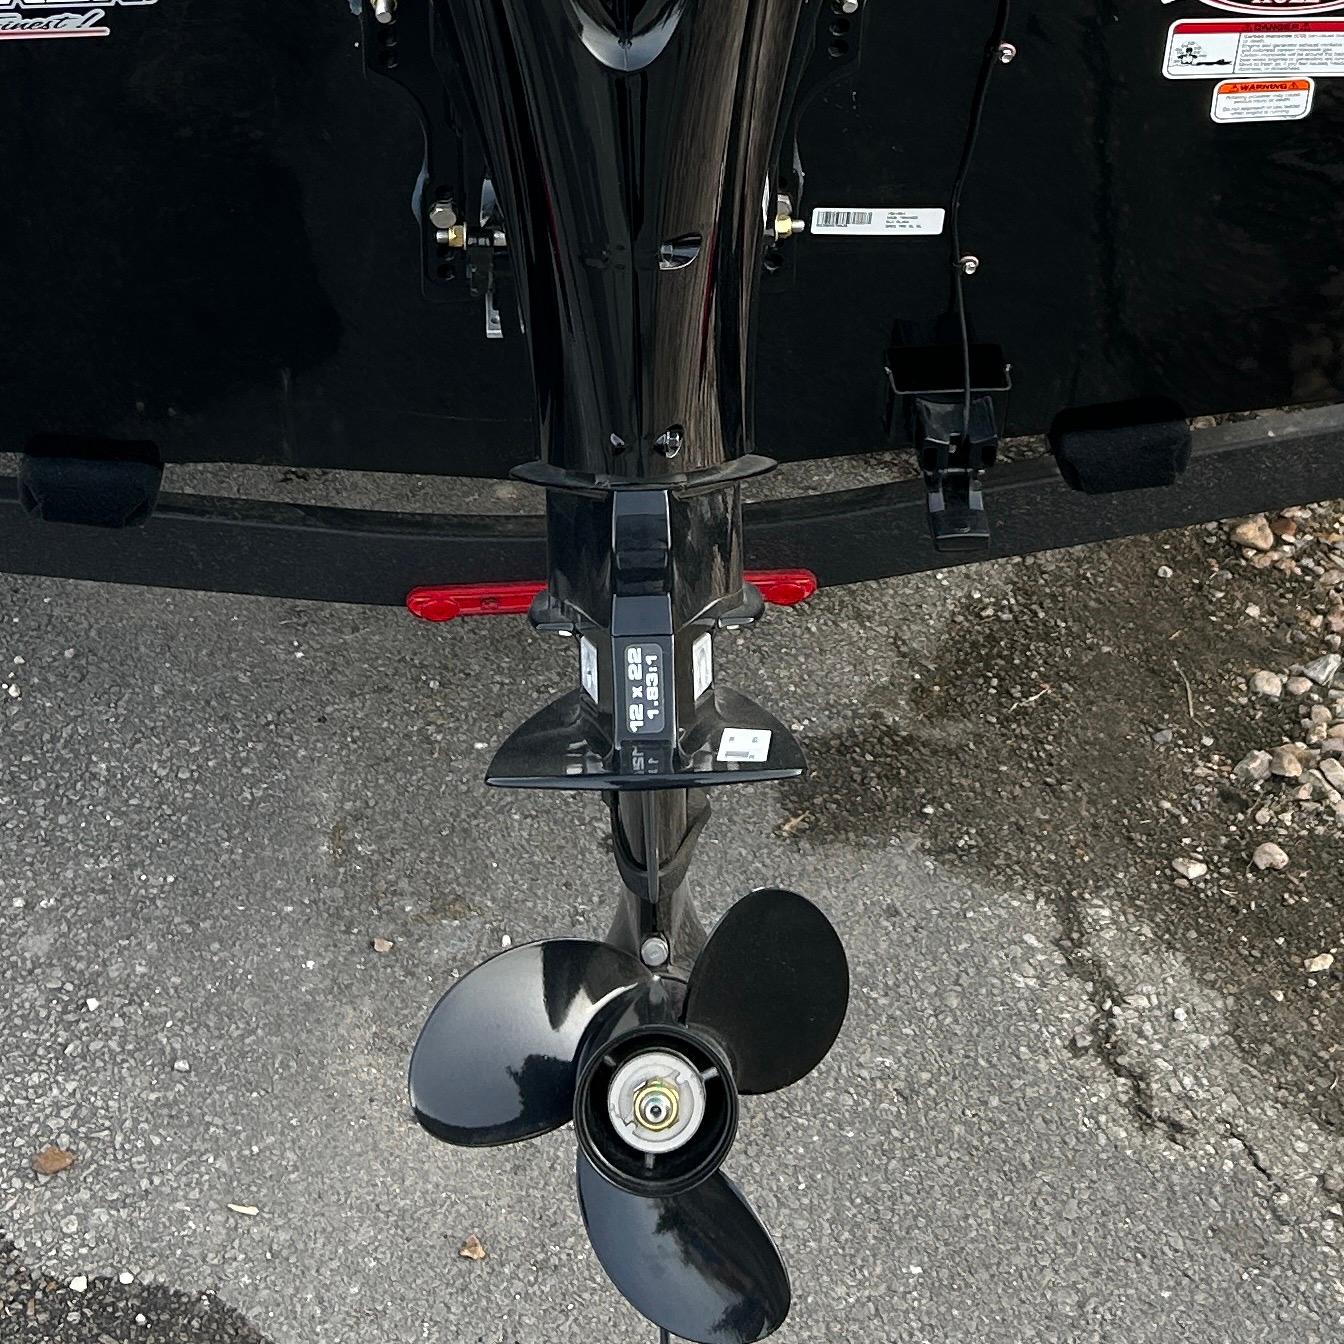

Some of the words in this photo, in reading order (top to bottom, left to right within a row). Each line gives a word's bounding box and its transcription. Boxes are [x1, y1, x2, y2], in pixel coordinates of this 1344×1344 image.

[627, 647, 643, 681] 22
[645, 654, 660, 720] 1.83:1
[628, 704, 645, 733] 12
